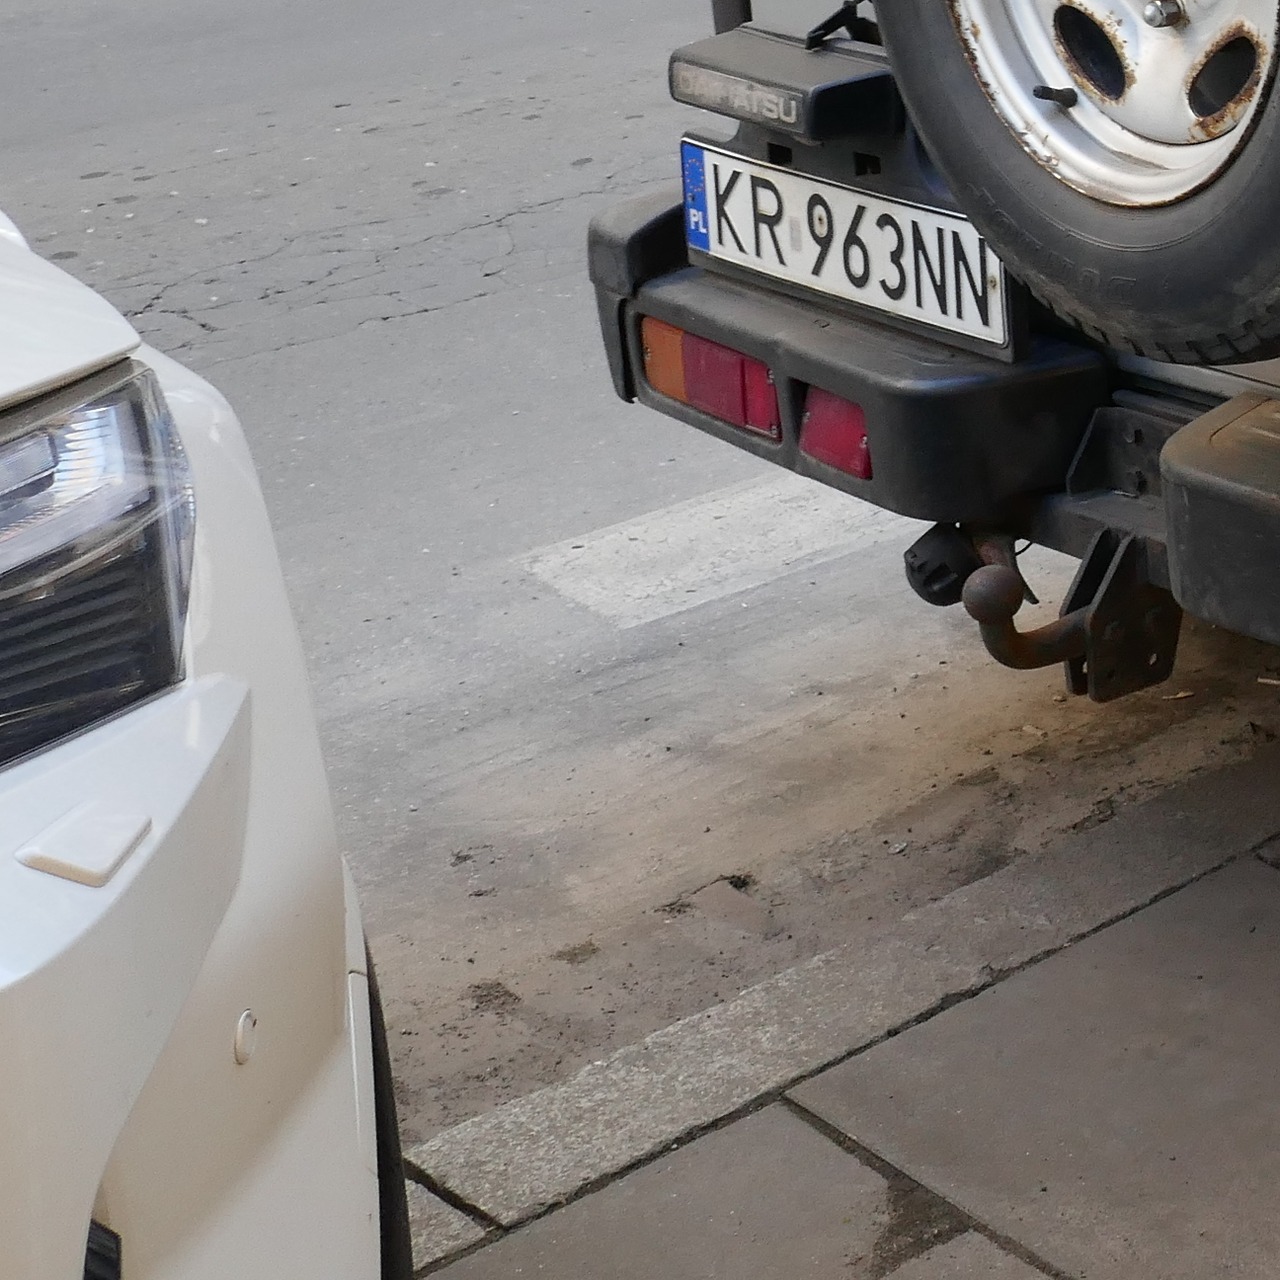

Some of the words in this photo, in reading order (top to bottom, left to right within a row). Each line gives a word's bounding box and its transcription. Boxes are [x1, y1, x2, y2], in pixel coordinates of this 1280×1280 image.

[689, 208, 708, 234] PL
[712, 162, 788, 267] KR
[806, 192, 991, 328] 963NN
